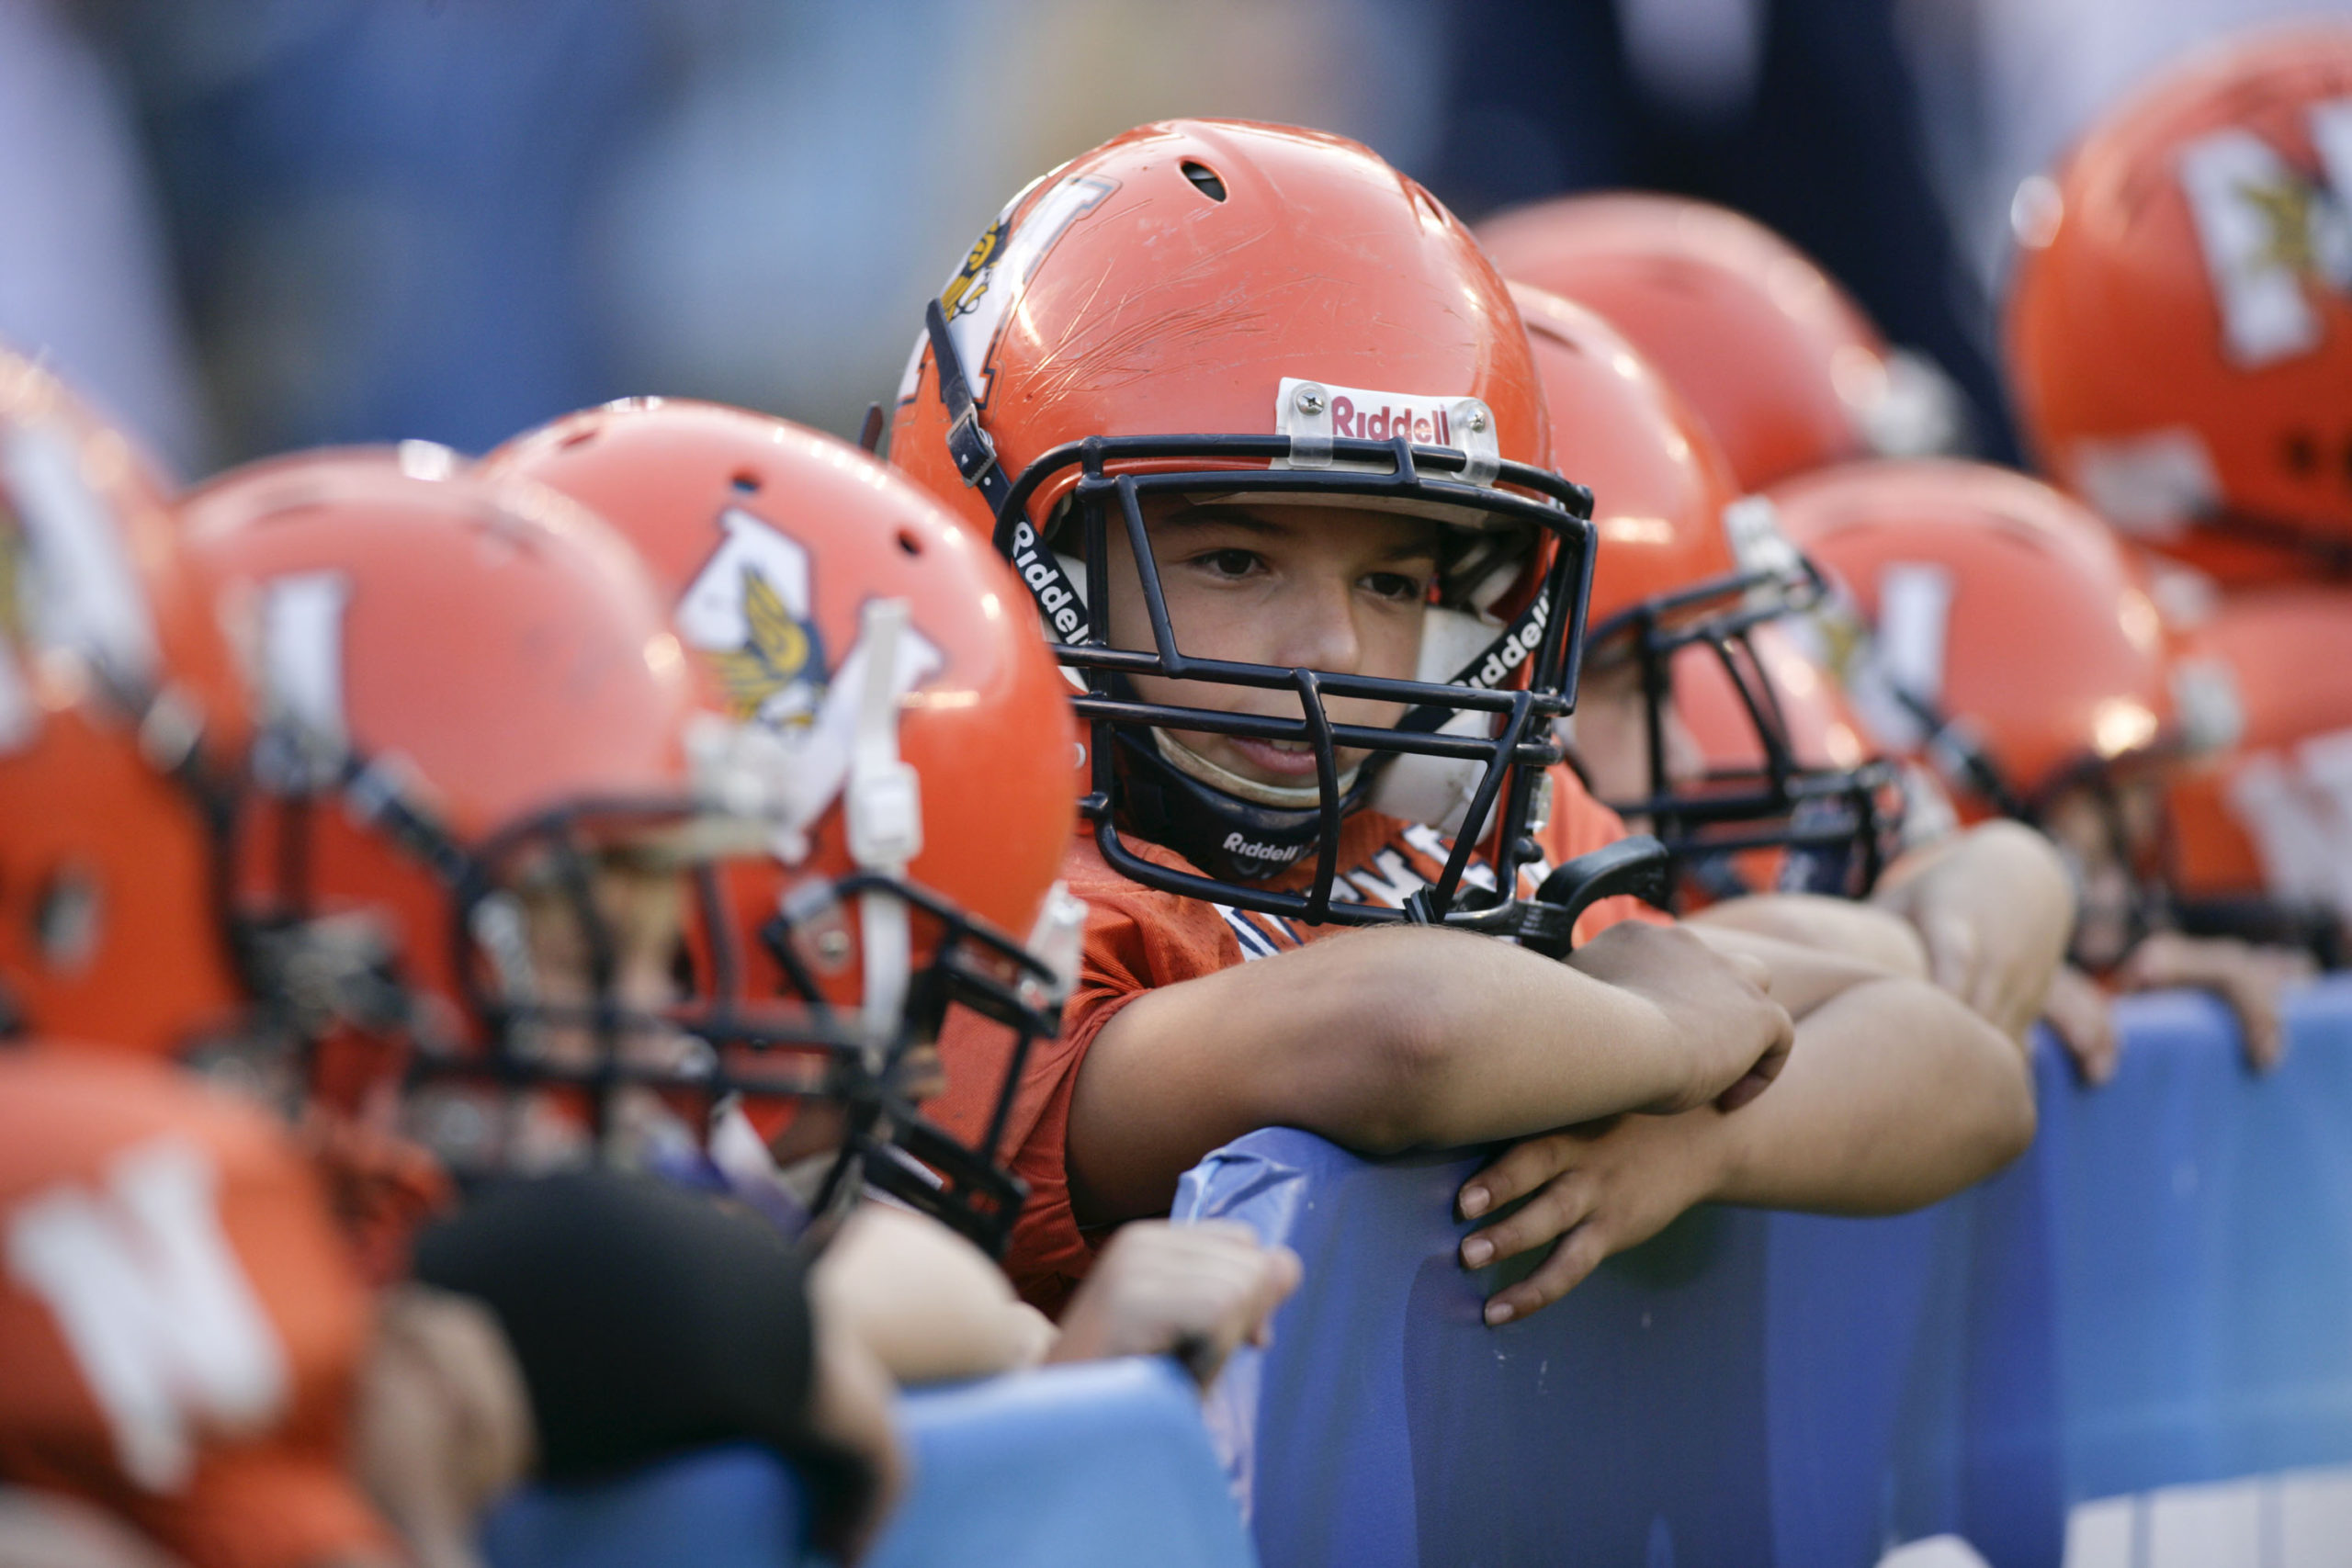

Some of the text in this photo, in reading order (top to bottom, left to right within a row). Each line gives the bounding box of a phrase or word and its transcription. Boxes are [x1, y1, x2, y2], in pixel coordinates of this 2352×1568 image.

[1331, 395, 1451, 446] Riddell
[1012, 521, 1090, 646] Riddel
[1451, 595, 1550, 690] iddell
[1222, 831, 1299, 862] Riddell
